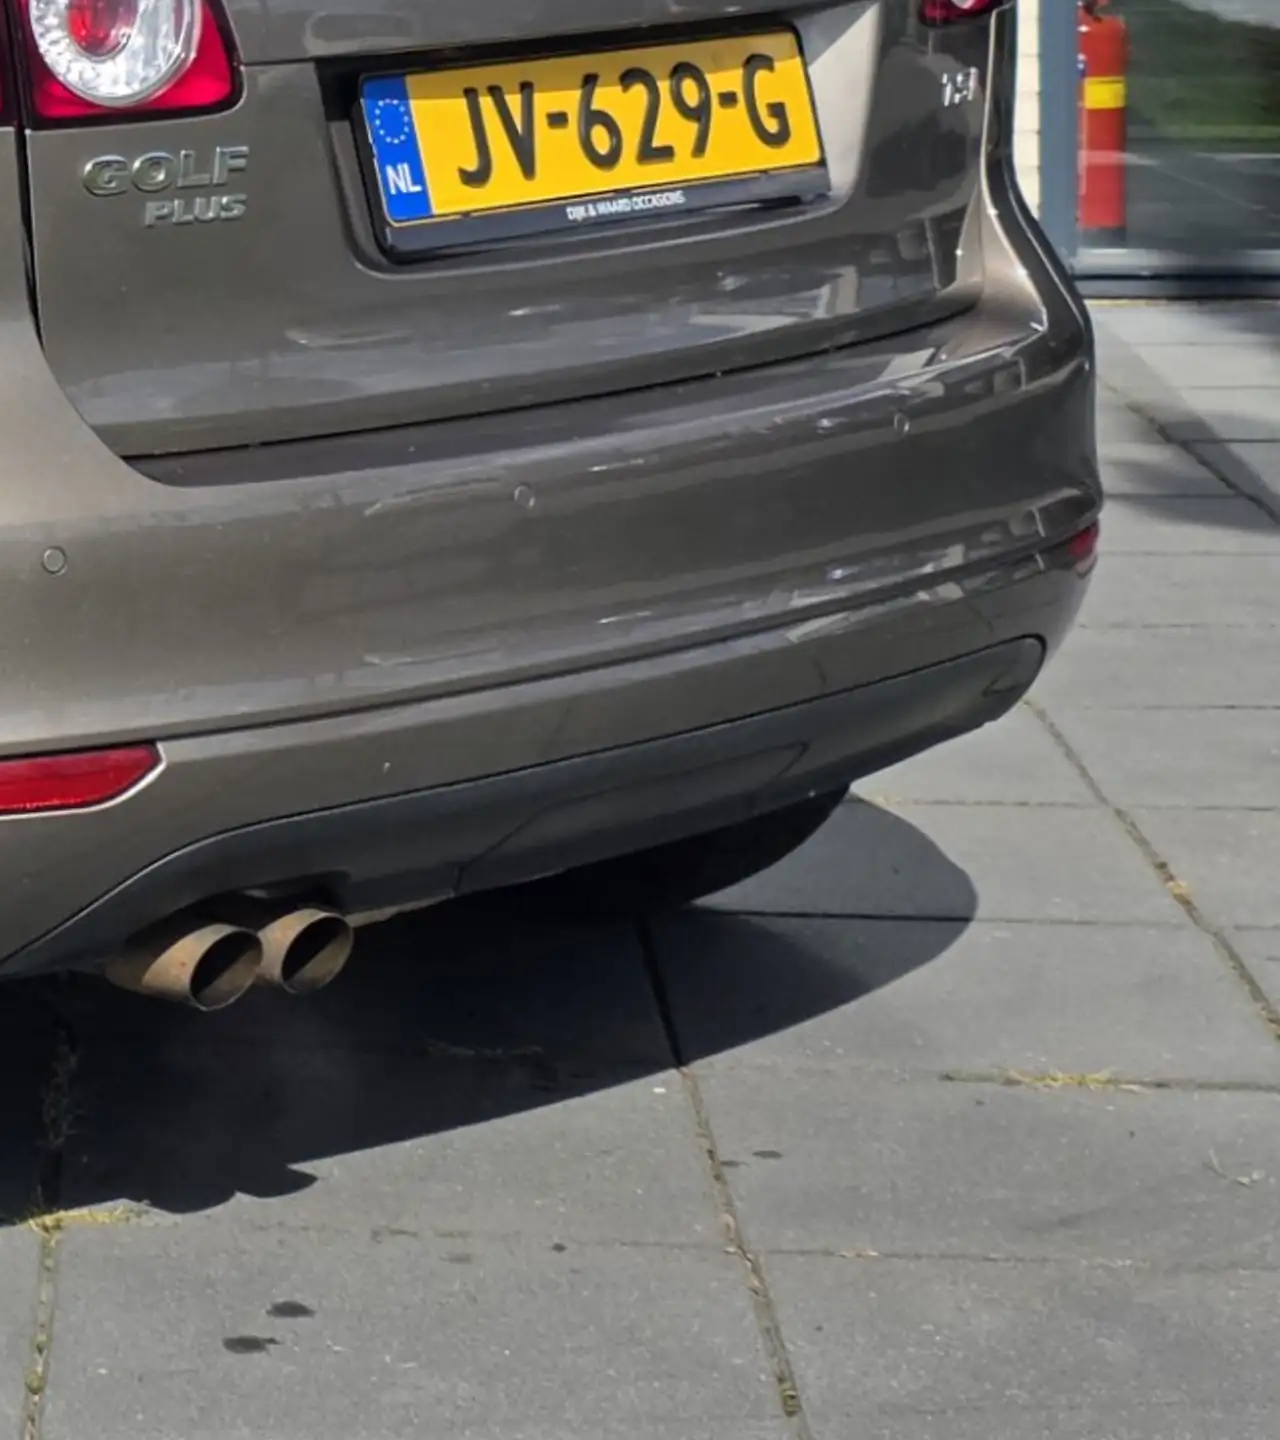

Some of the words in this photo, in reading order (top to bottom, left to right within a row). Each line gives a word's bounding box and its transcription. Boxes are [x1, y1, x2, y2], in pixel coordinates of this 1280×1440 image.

[458, 53, 792, 188] JV-629-G
[83, 146, 249, 196] GOLF
[386, 163, 422, 195] NL
[145, 194, 248, 227] PLUS
